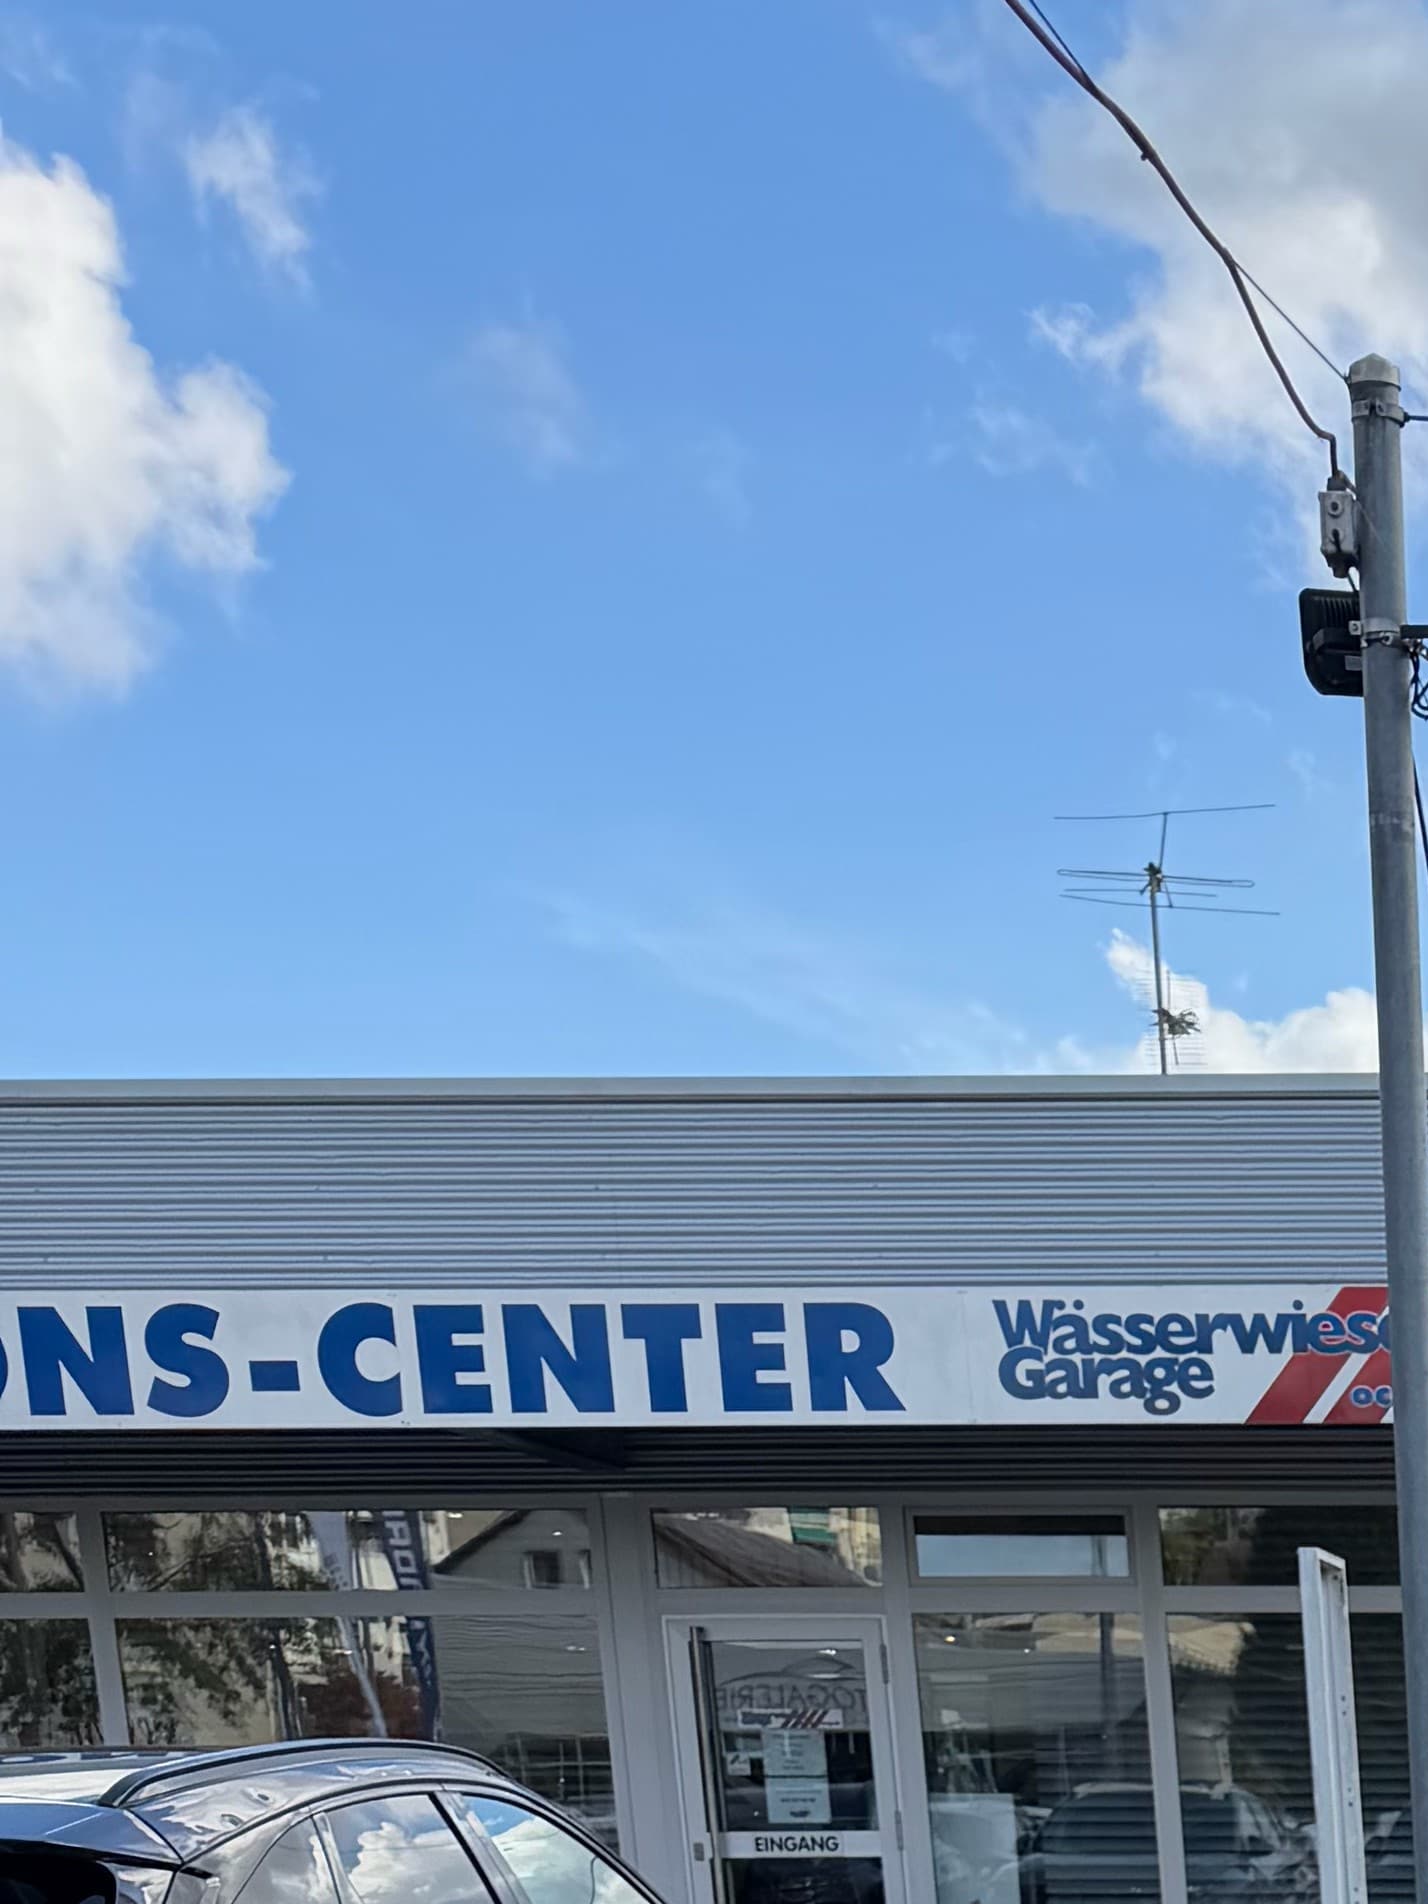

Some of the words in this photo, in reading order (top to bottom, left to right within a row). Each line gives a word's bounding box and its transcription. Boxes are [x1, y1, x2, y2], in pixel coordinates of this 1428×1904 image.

[0, 1302, 905, 1418] NS-CENTER
[999, 1345, 1215, 1415] Garage
[754, 1836, 840, 1852] EINGANG
